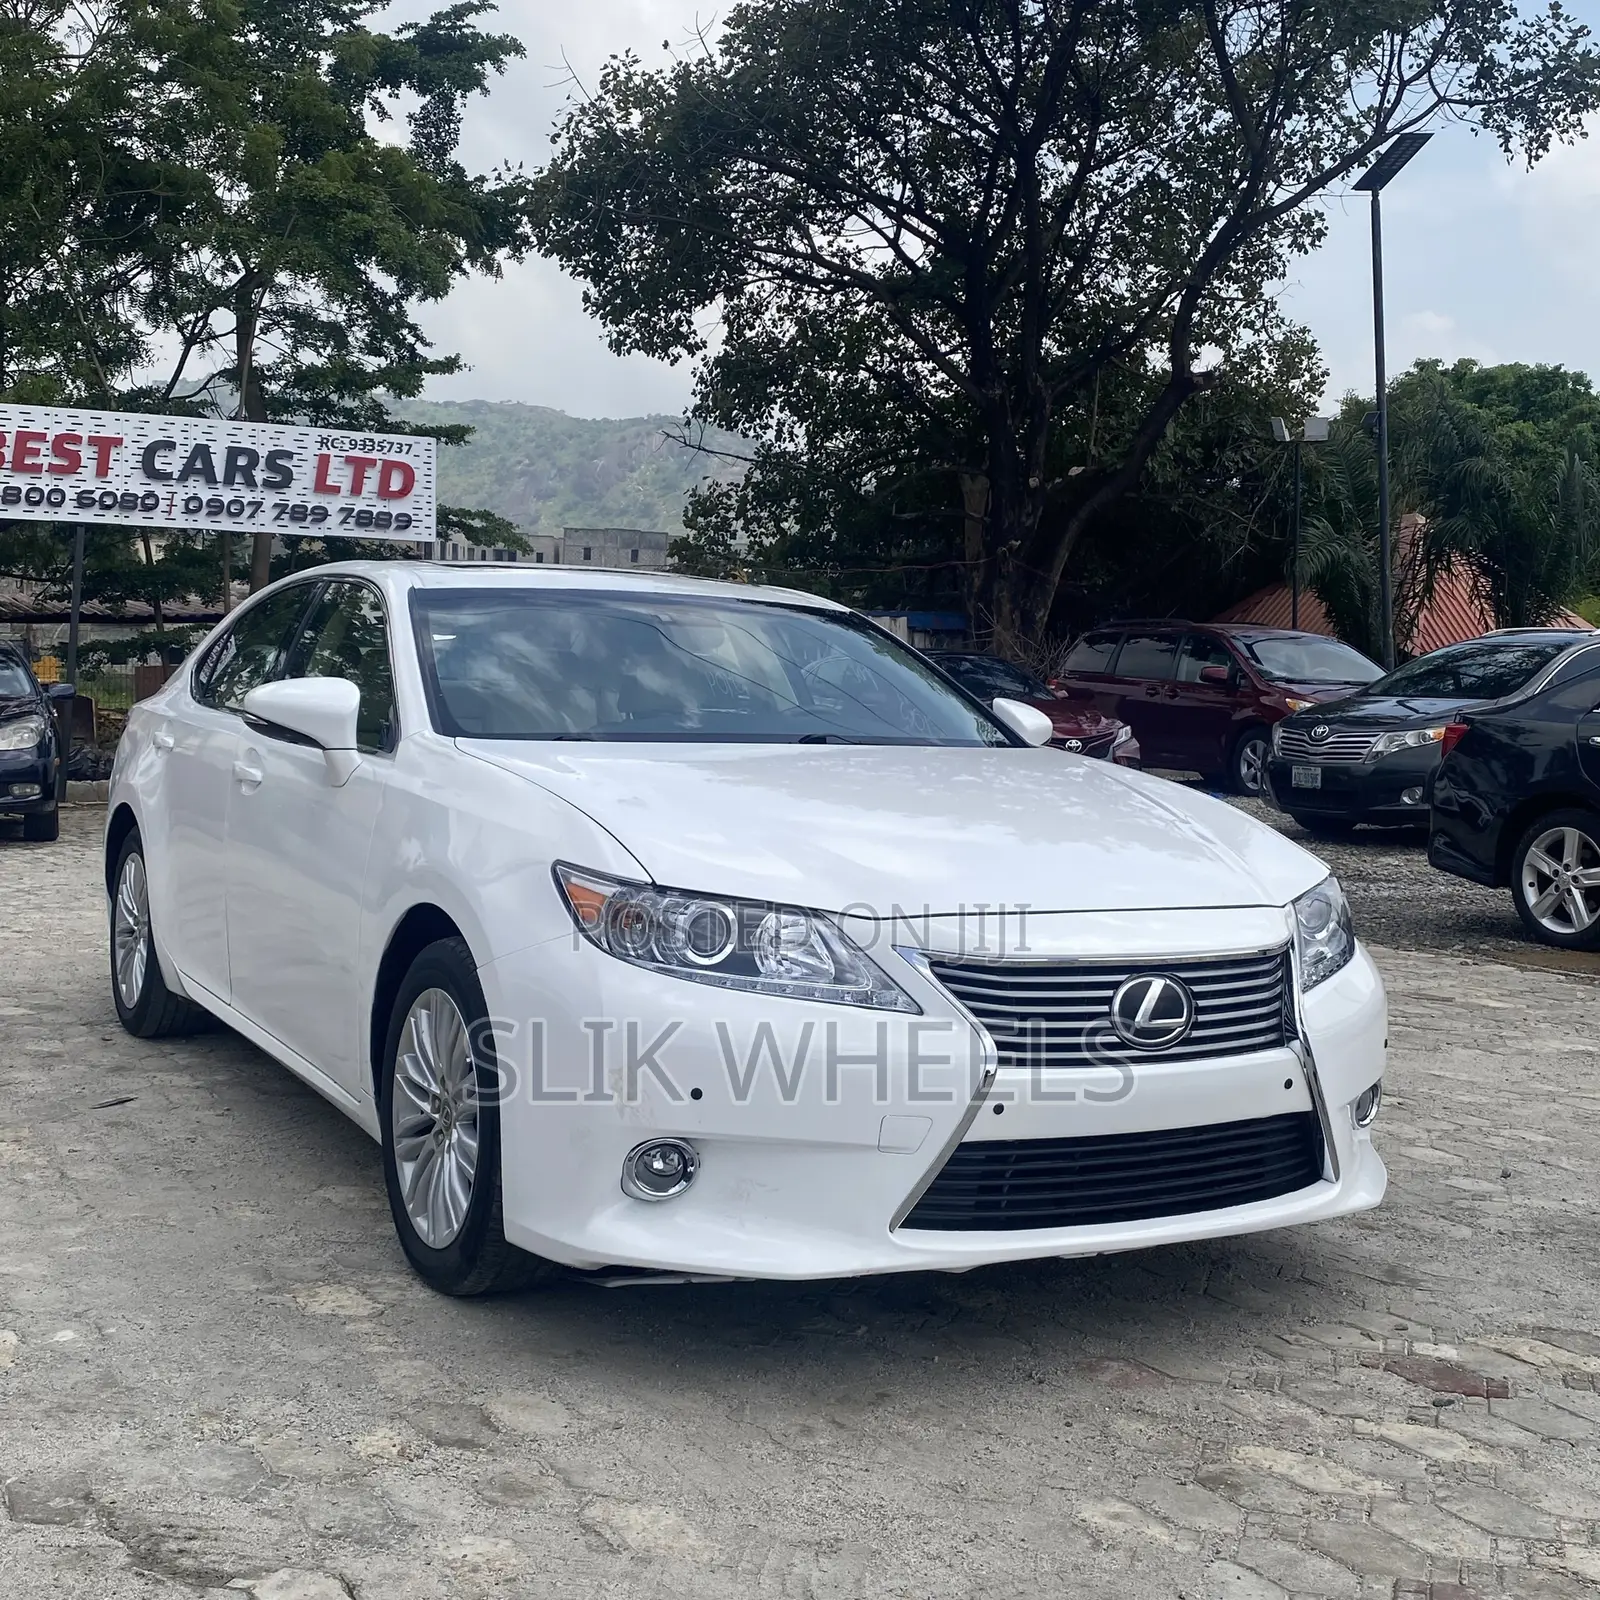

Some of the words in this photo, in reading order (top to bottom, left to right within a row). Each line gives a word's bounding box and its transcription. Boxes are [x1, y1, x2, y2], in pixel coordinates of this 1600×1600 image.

[0, 430, 124, 478] EST
[141, 440, 294, 489] CARS
[313, 453, 416, 500] LTD
[76, 490, 160, 513] 6080
[184, 496, 263, 519] 0907
[272, 502, 329, 524] 789
[338, 506, 413, 530] 7889
